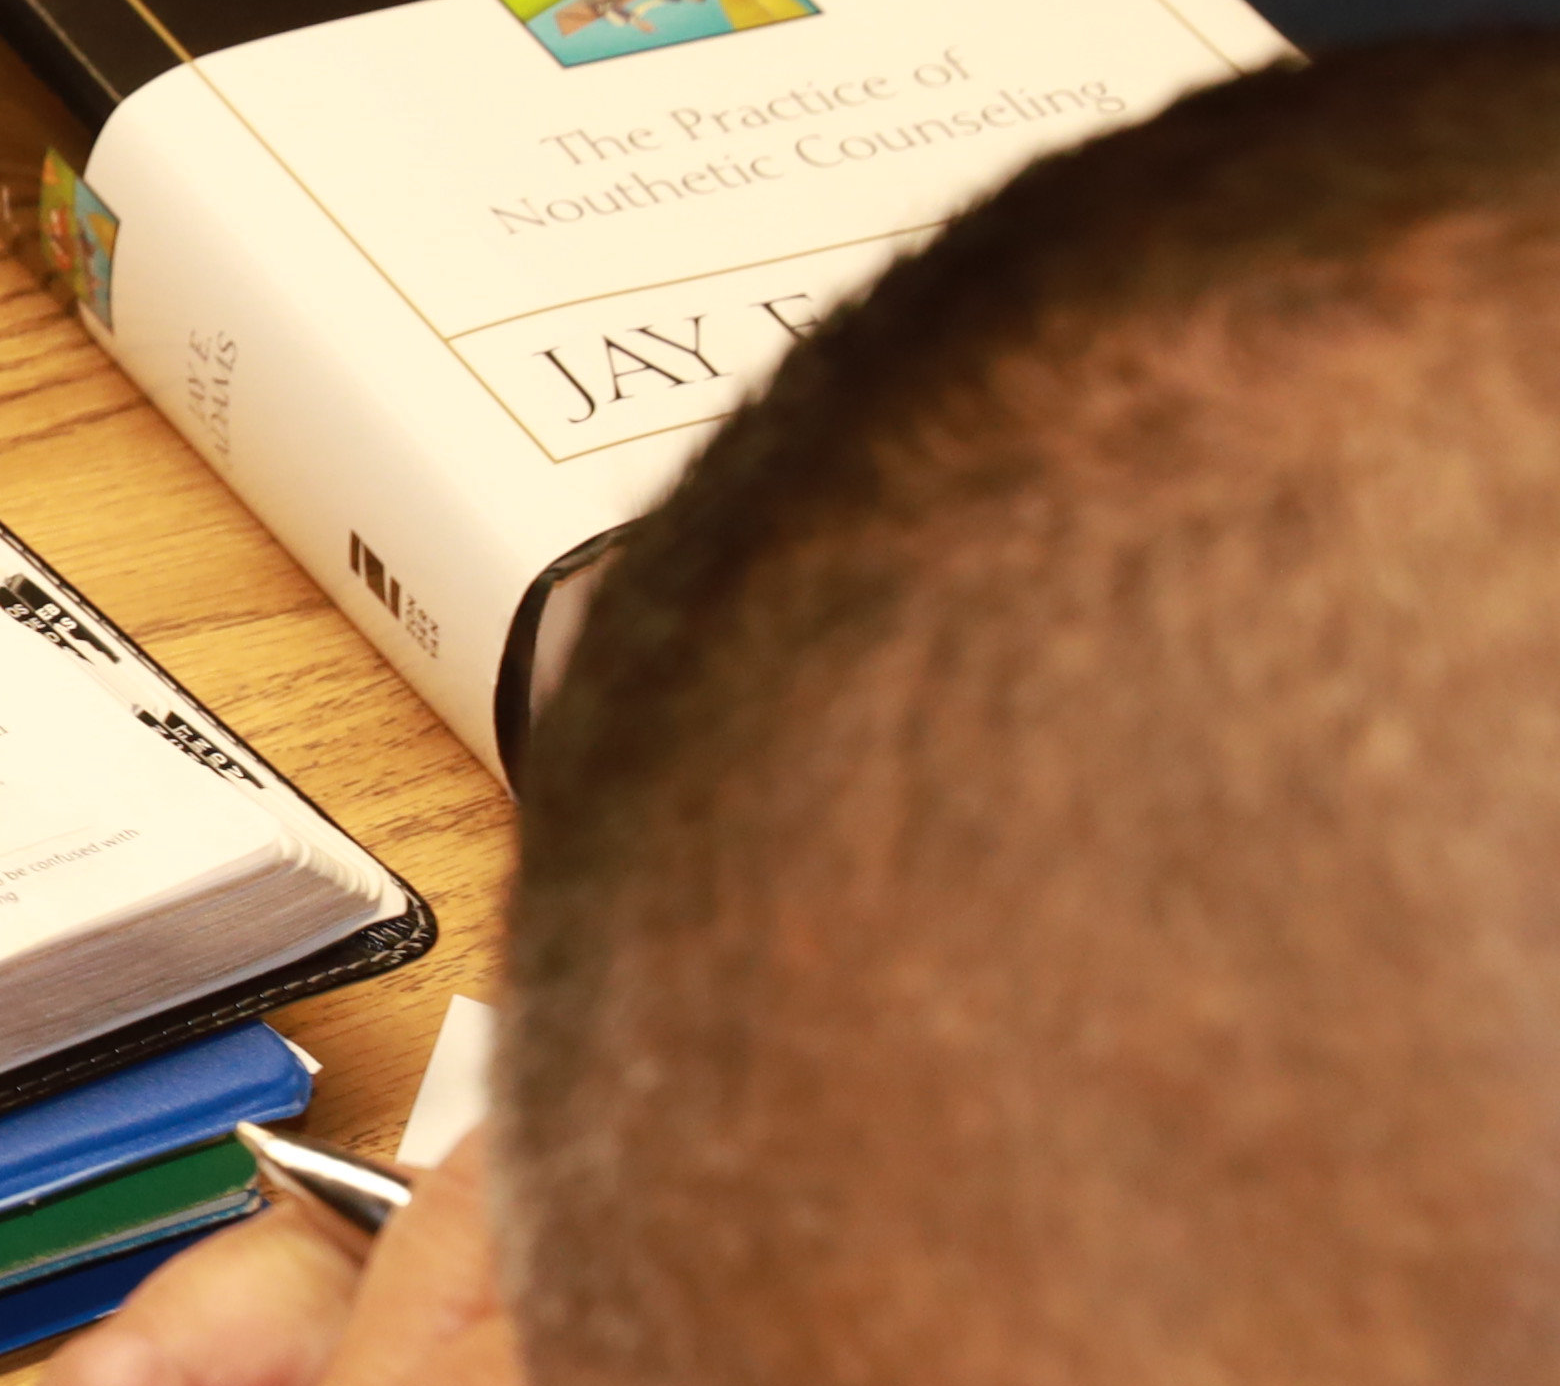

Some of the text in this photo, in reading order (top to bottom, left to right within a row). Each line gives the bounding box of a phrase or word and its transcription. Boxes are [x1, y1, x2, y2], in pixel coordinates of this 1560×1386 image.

[489, 76, 1128, 237] Nouthetic Counseling
[539, 45, 976, 169] The Practice of
[531, 314, 733, 425] JAY
